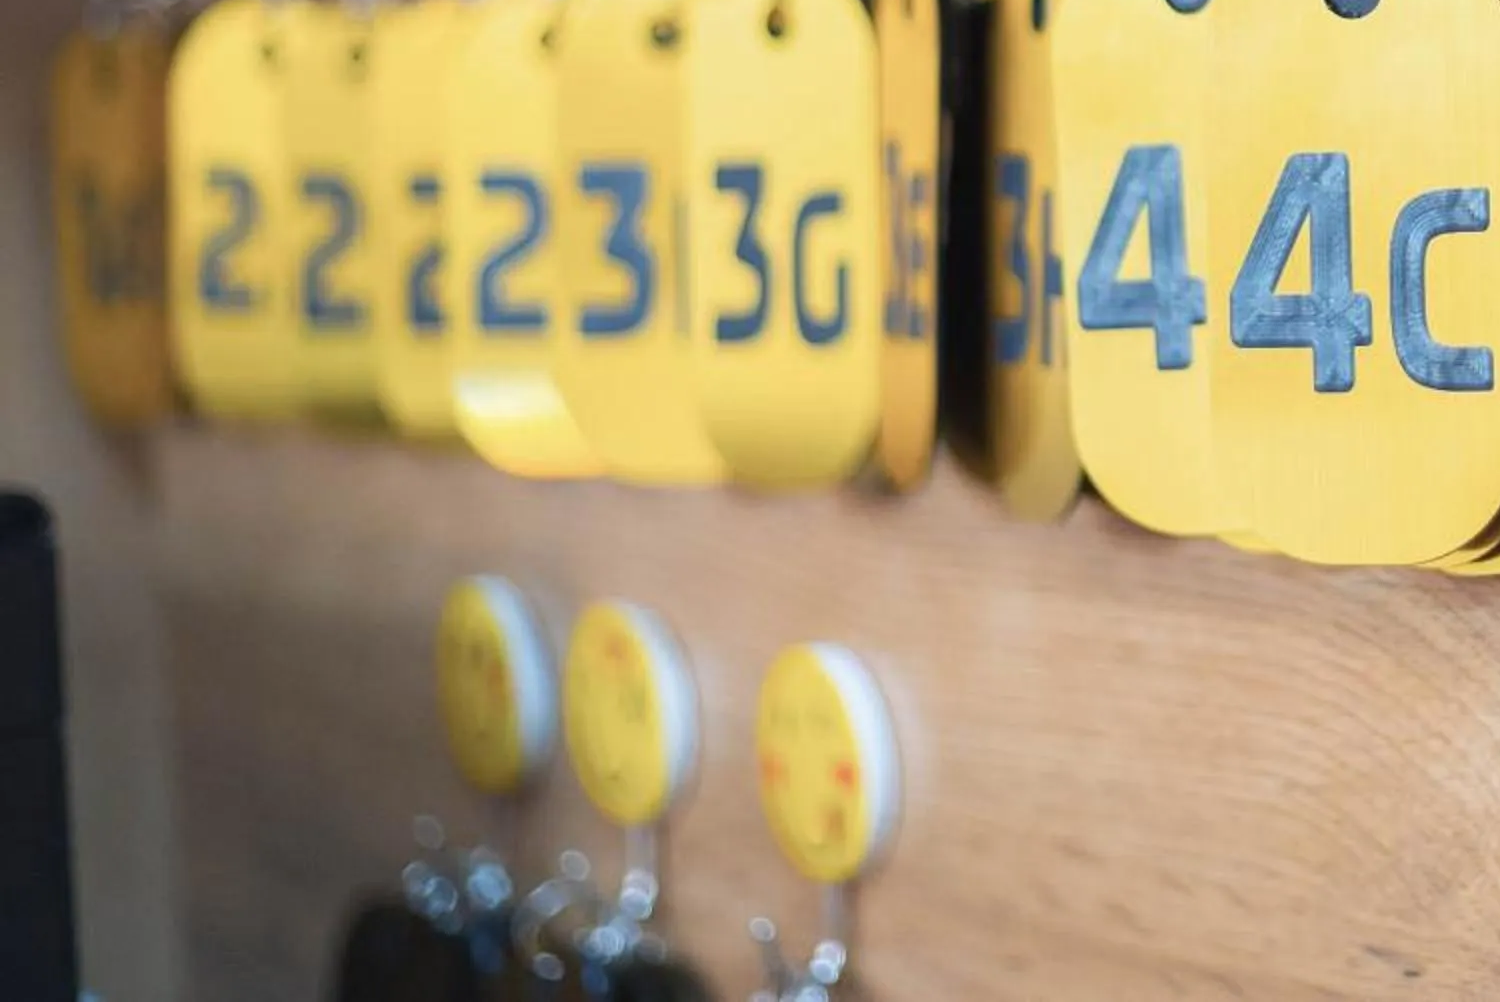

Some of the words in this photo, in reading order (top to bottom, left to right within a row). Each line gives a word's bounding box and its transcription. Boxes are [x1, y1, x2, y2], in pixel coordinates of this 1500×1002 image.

[200, 166, 258, 311] 2
[302, 175, 365, 327] 2
[473, 168, 549, 331] 2
[576, 162, 692, 337] 3
[715, 164, 850, 346] 3G
[1078, 144, 1206, 370] 4
[1230, 152, 1494, 392] 4C
